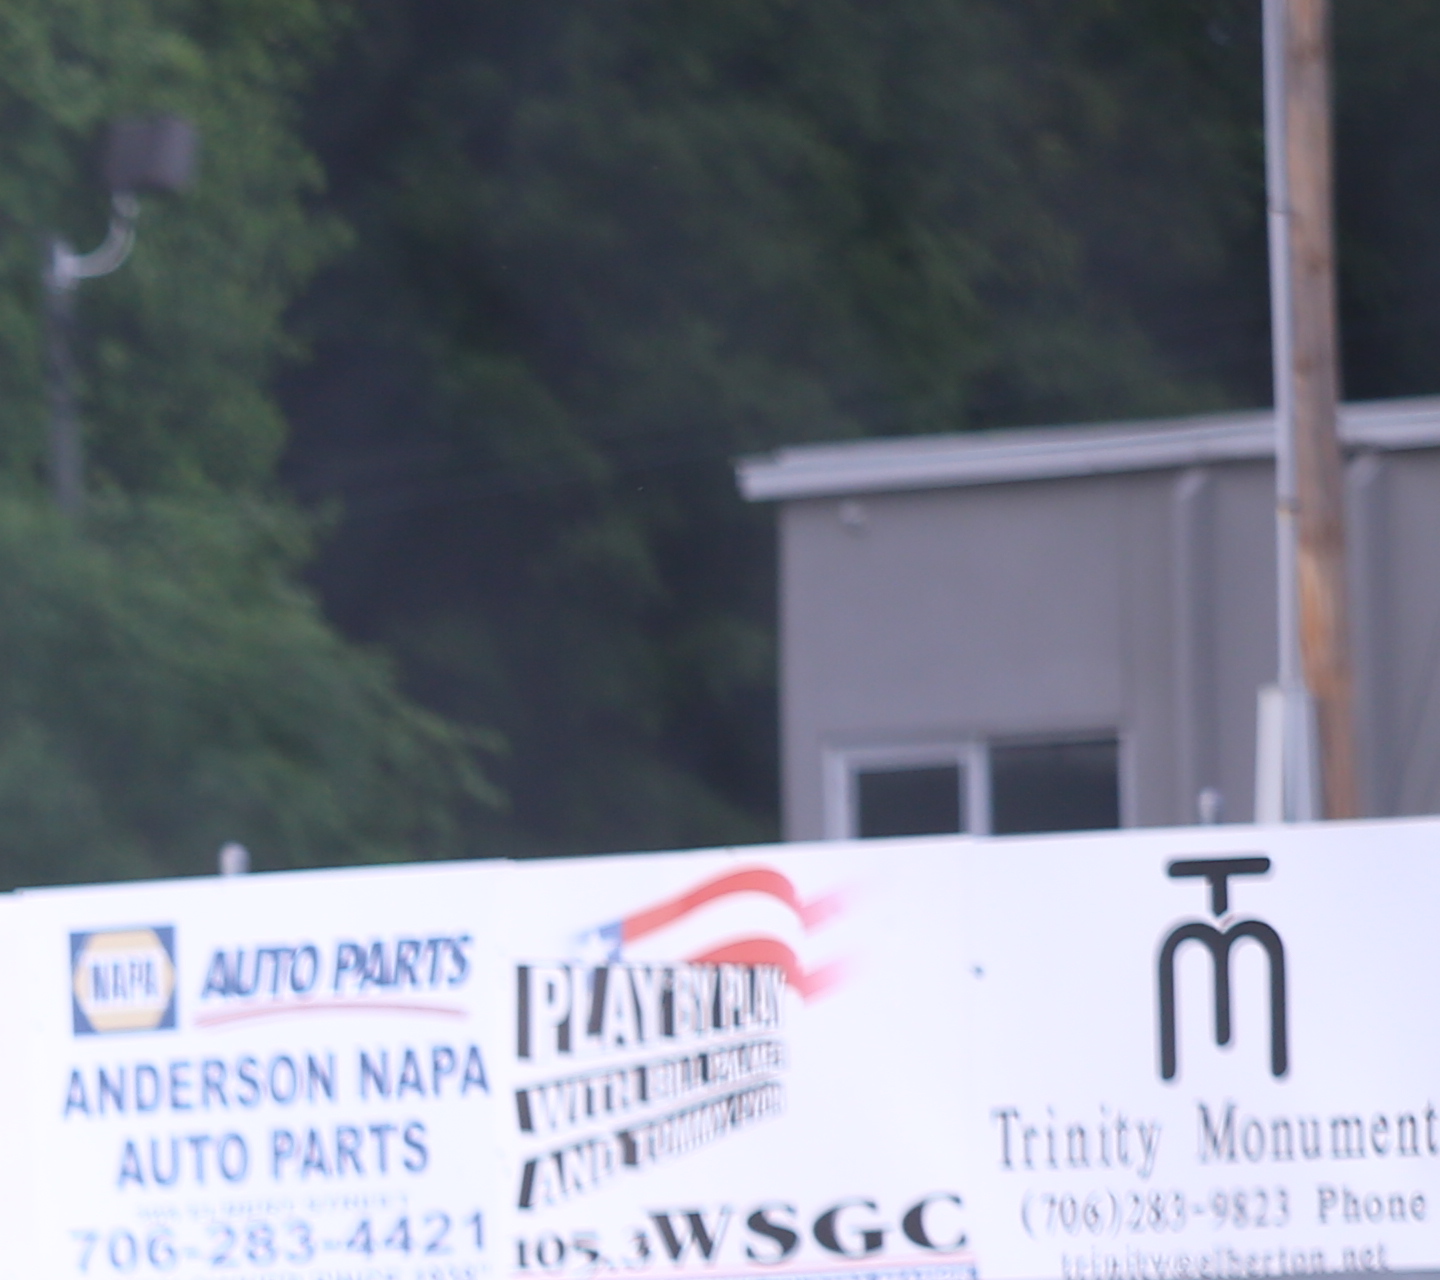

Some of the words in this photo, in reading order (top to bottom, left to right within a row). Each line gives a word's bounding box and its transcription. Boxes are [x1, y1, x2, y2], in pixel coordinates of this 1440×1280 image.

[91, 956, 160, 1002] NAPA
[201, 941, 322, 1001] AUTO
[333, 932, 476, 990] PARTS
[515, 961, 668, 1061] PLAY
[63, 1052, 337, 1119] ANDERSON
[359, 1042, 492, 1100] NAPA
[117, 1132, 250, 1190] AUTO
[272, 1118, 431, 1182] PARTS
[992, 1104, 1162, 1180] Trinity
[1194, 1098, 1440, 1167] Monument
[68, 1210, 486, 1274] 706-283-4421
[646, 1190, 970, 1268] WSGC
[1316, 1185, 1427, 1227] Phone
